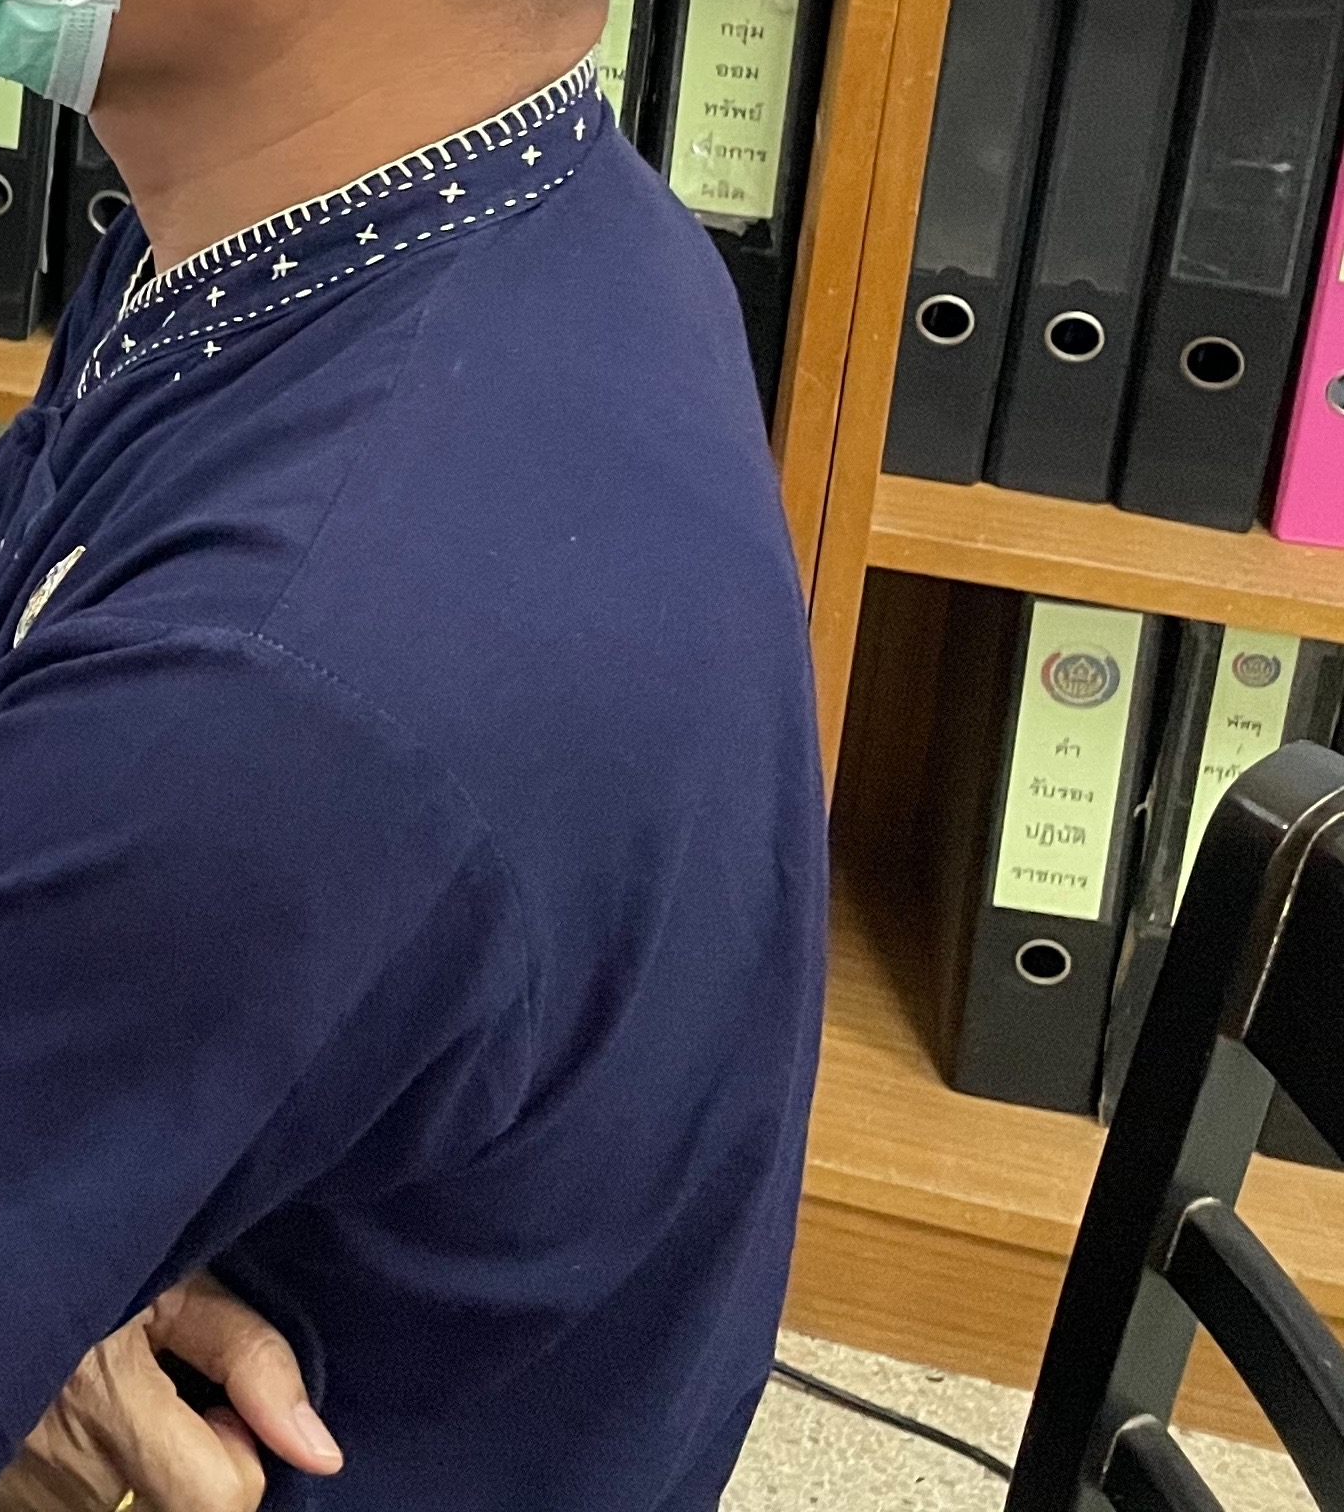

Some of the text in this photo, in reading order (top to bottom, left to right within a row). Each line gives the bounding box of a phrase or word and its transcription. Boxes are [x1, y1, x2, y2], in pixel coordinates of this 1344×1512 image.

[721, 19, 764, 45] กลุ่ม
[716, 63, 759, 80] ออม
[704, 98, 764, 122] ทรัพย์
[1011, 866, 1088, 888] ราชการ
